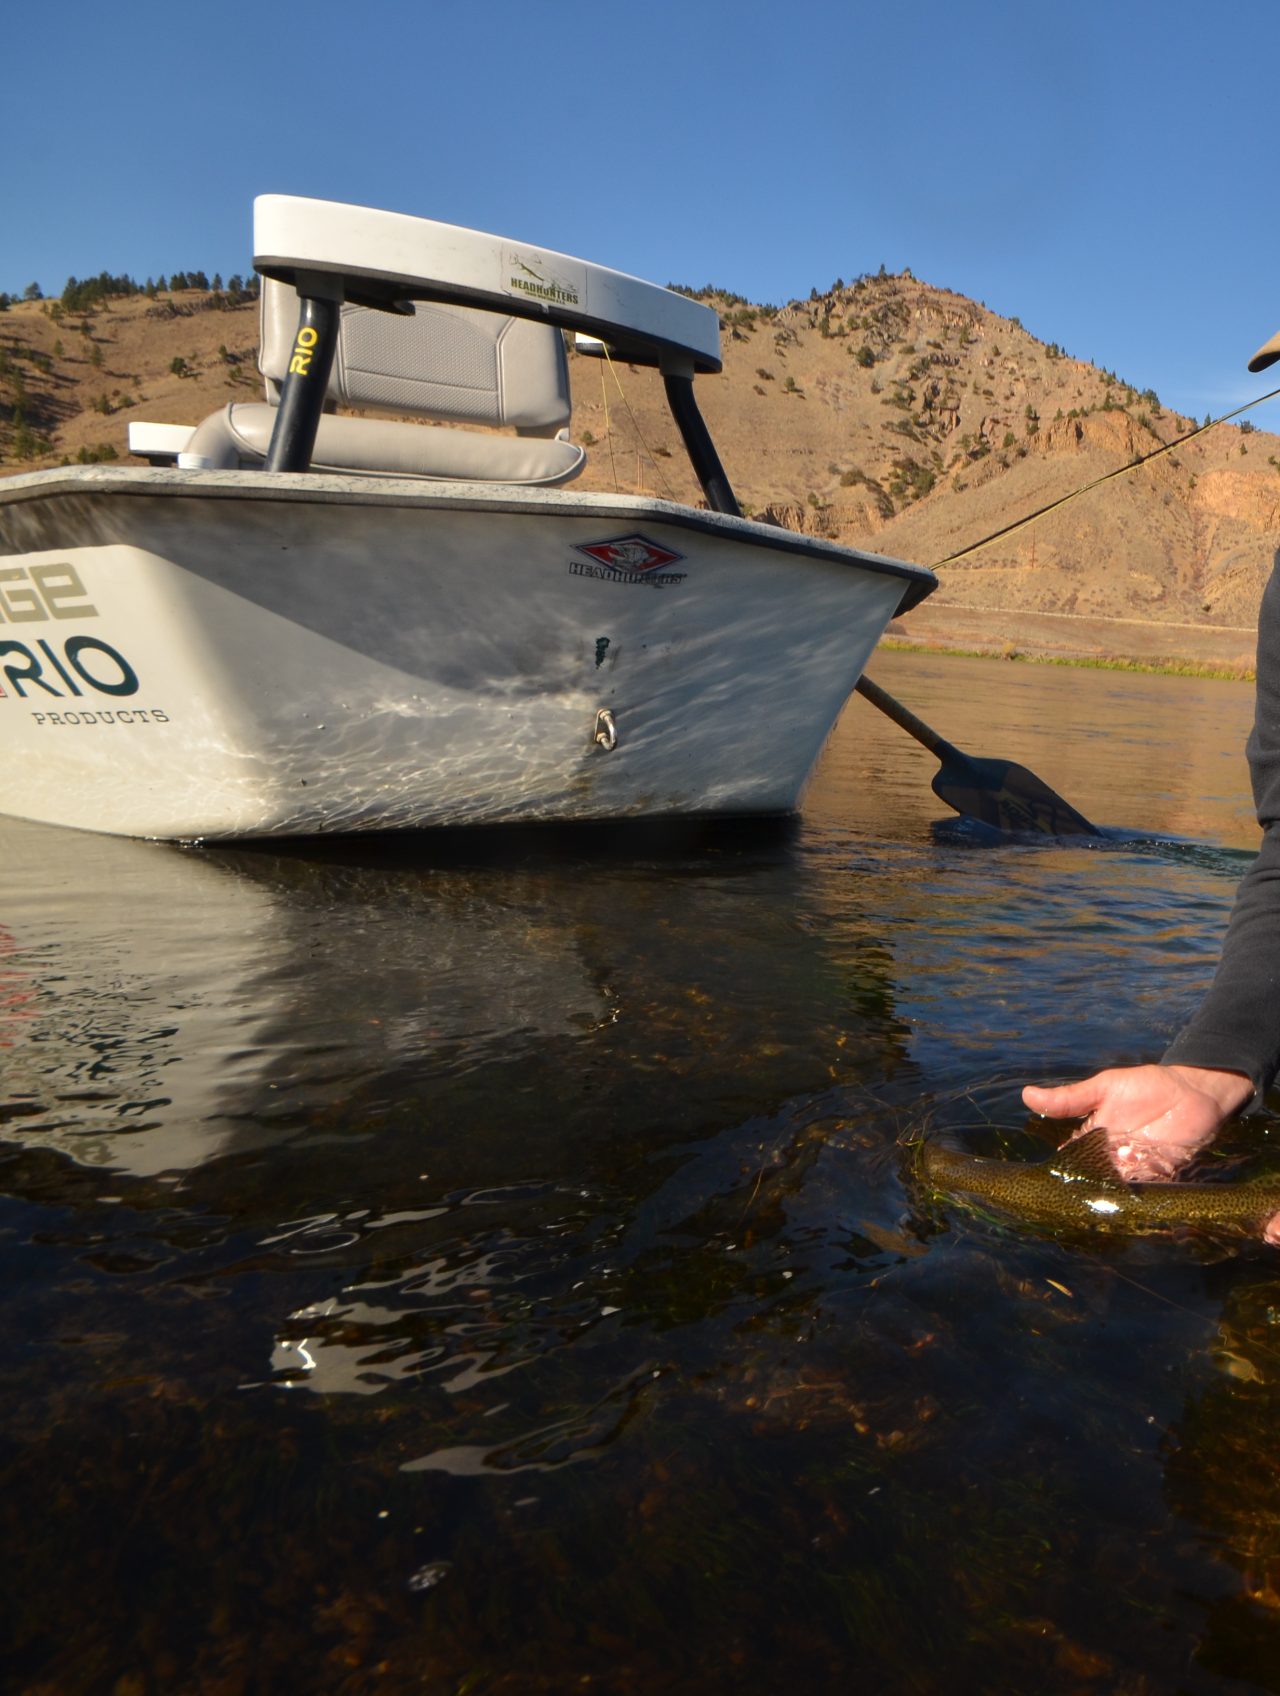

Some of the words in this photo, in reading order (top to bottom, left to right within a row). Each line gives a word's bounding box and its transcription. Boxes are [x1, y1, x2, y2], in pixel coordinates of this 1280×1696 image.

[511, 277, 579, 305] HEADHUNTERS
[289, 326, 318, 376] RIO
[0, 635, 139, 698] RIO
[32, 709, 170, 725] PRODUCTS
